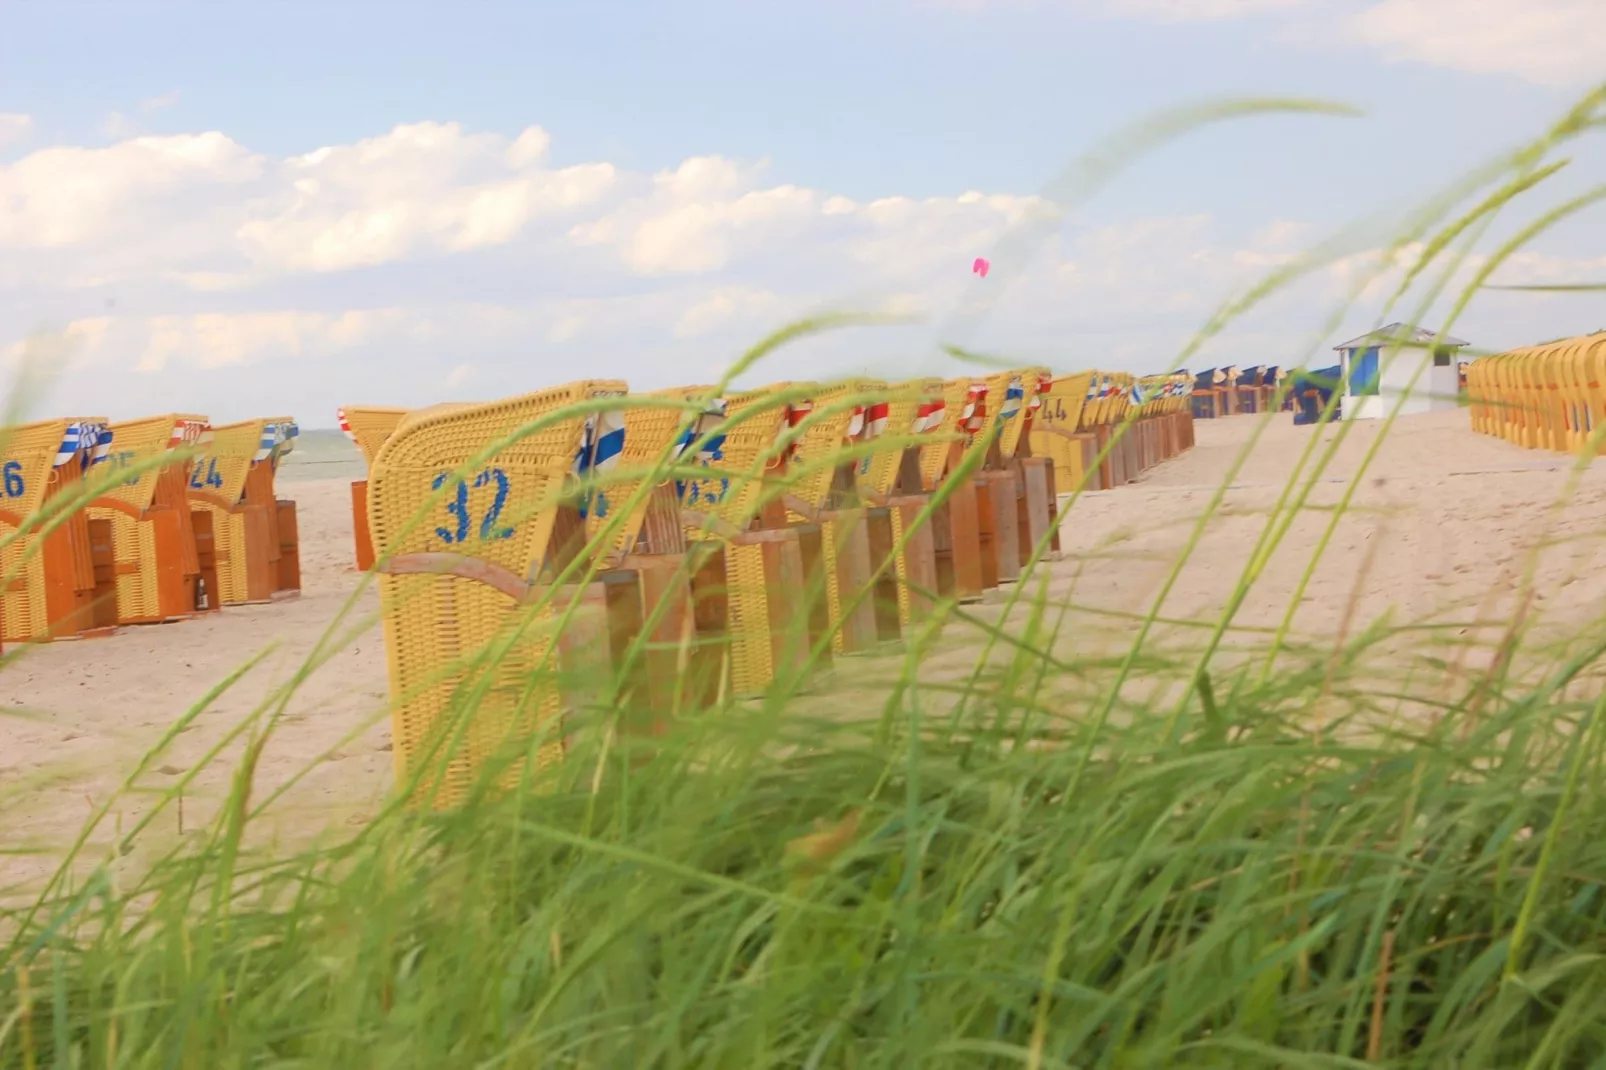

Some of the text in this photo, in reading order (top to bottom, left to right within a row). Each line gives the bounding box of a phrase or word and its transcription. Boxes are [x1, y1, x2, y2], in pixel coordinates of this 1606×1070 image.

[0, 460, 25, 498] 6
[190, 456, 223, 488] 24
[431, 466, 515, 544] 32
